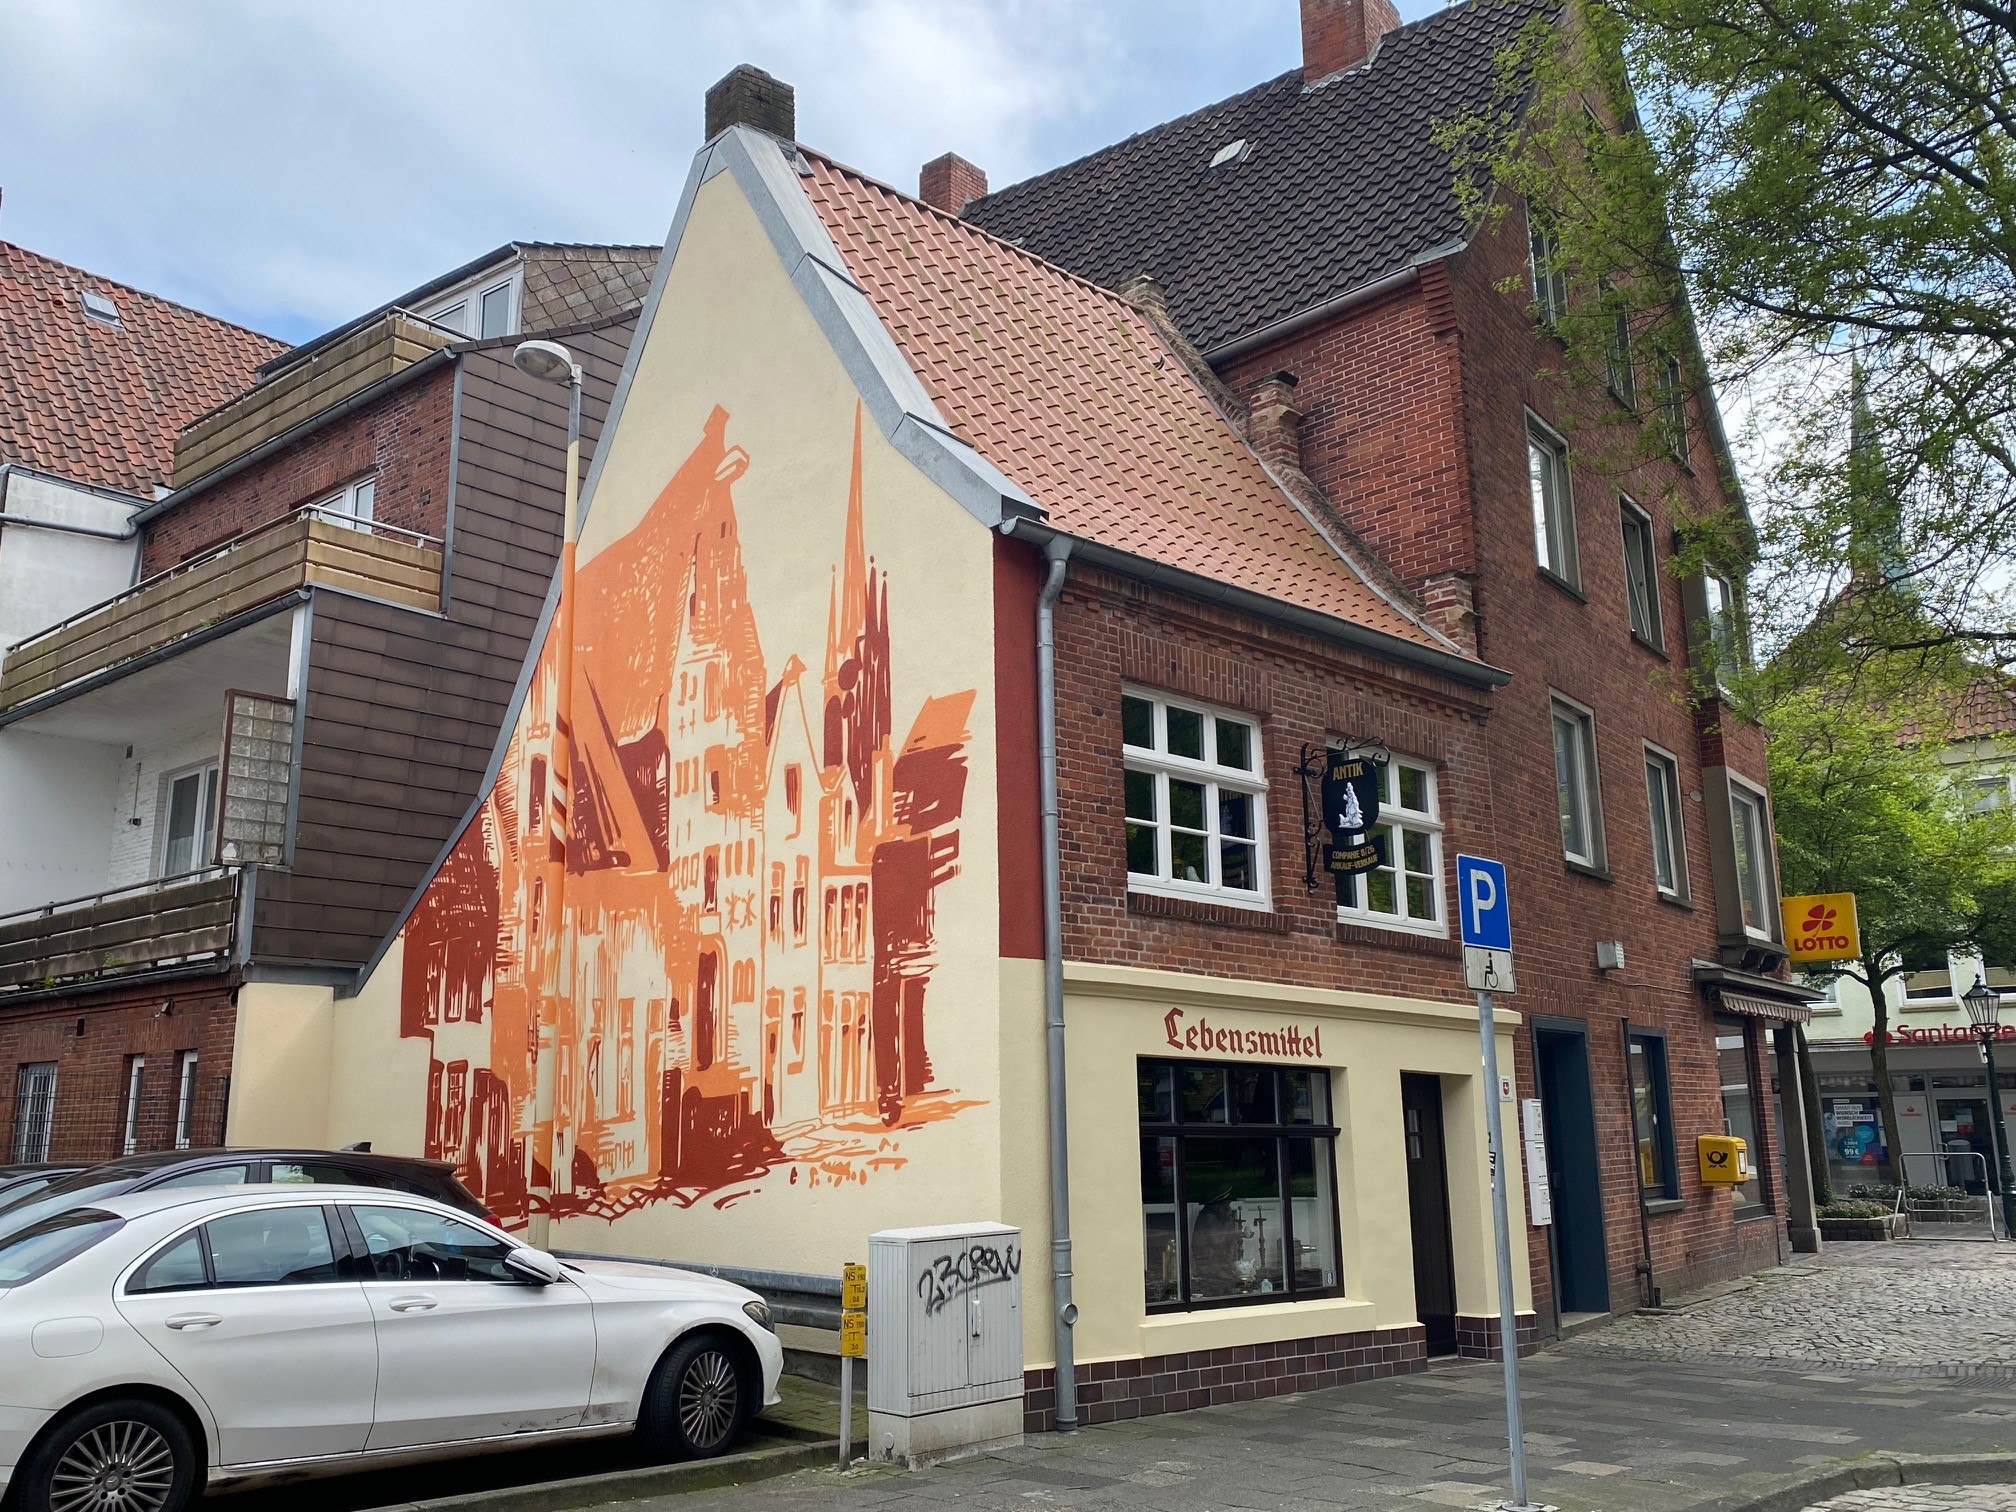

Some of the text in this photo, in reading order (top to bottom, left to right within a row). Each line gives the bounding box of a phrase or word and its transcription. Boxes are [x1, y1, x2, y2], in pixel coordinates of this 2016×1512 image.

[1333, 762, 1363, 780] ANTIK
[1330, 854, 1378, 870] ANKAUF-VERKAUF
[1470, 868, 1497, 934] P
[1794, 935, 1849, 952] LOTTO
[1164, 1007, 1323, 1059] Lebensmittel
[846, 1272, 856, 1281] NS
[843, 1319, 854, 1329] NS
